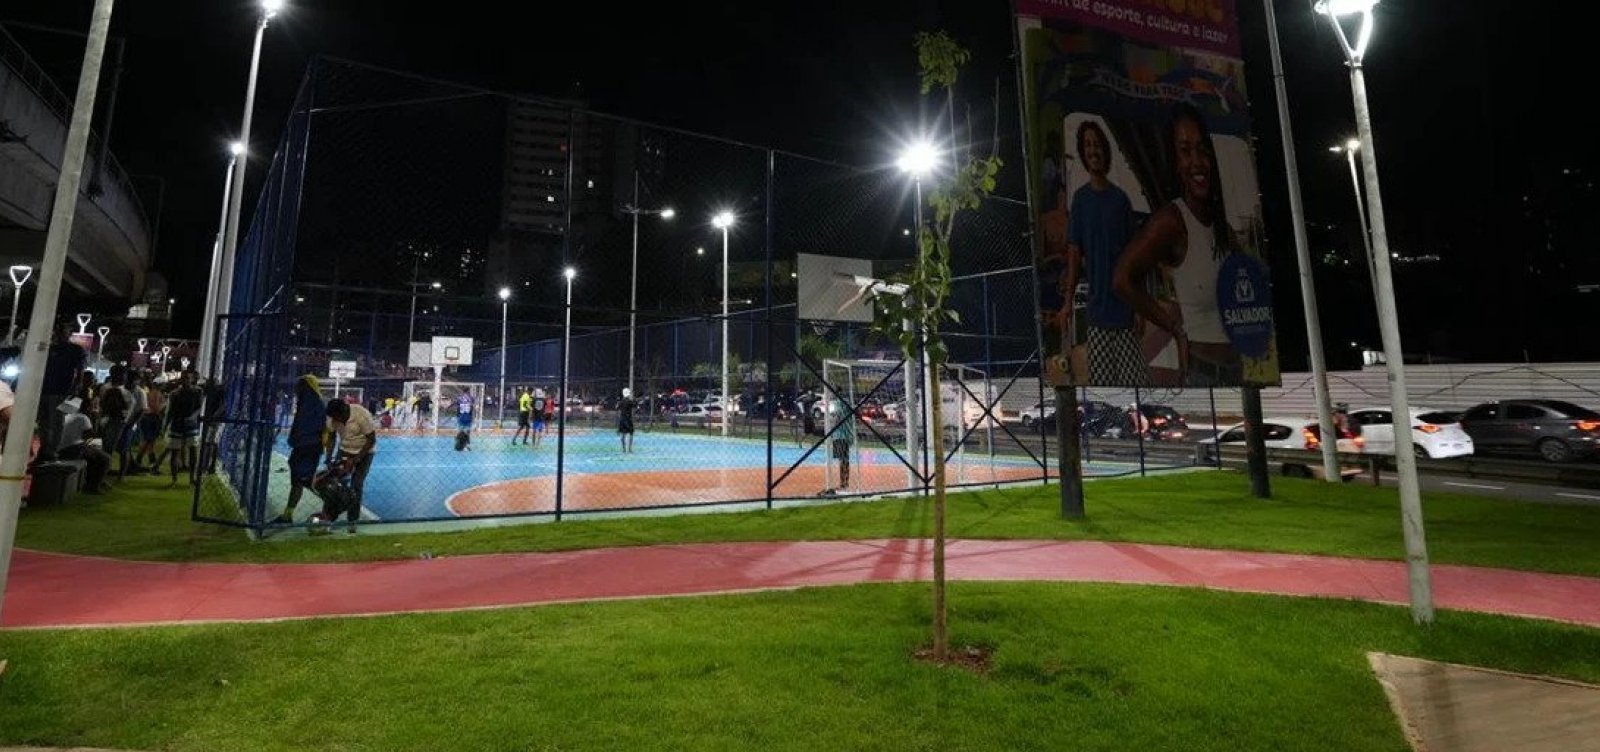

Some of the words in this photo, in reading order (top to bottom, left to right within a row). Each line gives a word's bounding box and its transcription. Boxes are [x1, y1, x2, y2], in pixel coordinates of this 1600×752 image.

[1073, 0, 1090, 11] de
[1094, 2, 1144, 26] esporte,
[1147, 15, 1190, 34] cultura
[1193, 26, 1201, 37] e
[1202, 25, 1228, 42] lazer
[1224, 306, 1273, 325] SALVADOR
